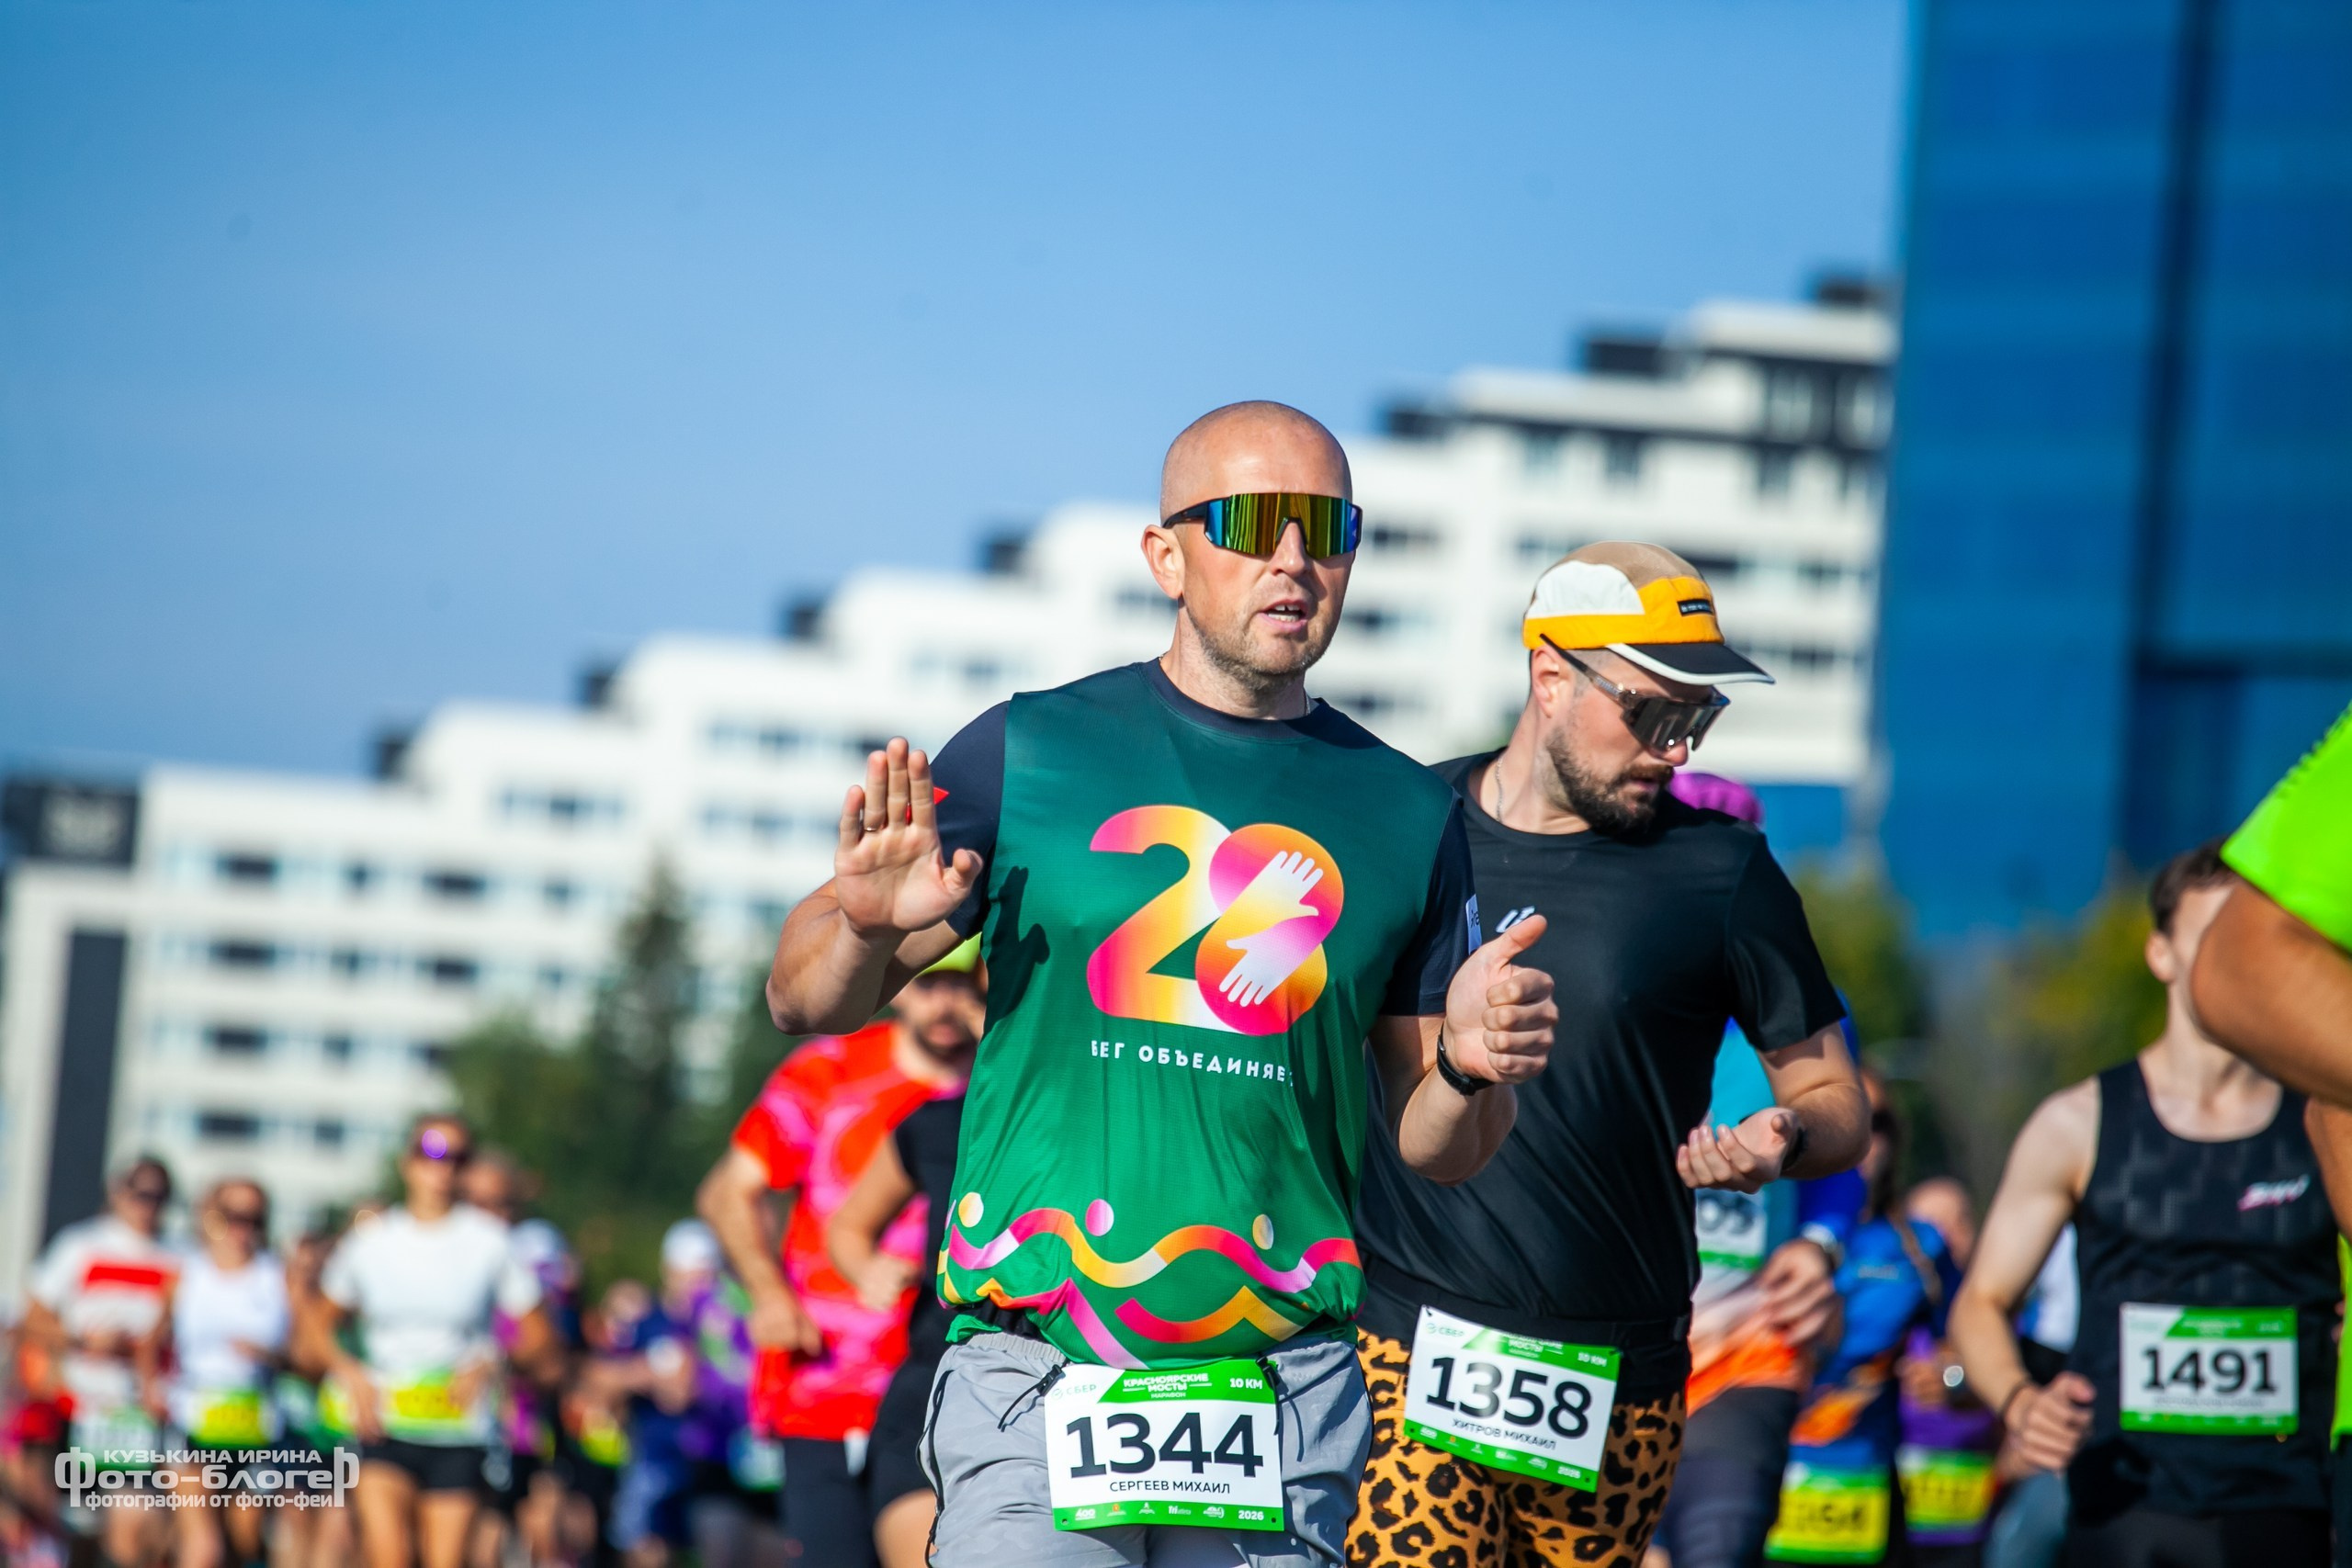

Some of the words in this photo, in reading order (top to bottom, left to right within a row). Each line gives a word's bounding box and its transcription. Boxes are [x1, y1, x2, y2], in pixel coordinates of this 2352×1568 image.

[1091, 1039, 1125, 1058] БЕГ
[1138, 1044, 1294, 1087] ОБЪЕДИНЯЕ
[2142, 1347, 2278, 1395] 1491
[1123, 1372, 1209, 1388] КРАСНОЯРСКИЕ
[1148, 1382, 1188, 1393] МОСТЫ
[1229, 1378, 1244, 1388] 10
[1066, 1383, 1097, 1395] СБЕР
[1426, 1357, 1592, 1439] 1358
[1452, 1418, 1501, 1438] ХИТРОВ
[1503, 1430, 1557, 1450] МИХАИЛ
[1066, 1412, 1264, 1479] 1344
[1109, 1479, 1170, 1493] СЕРГЕЕВ
[1172, 1481, 1231, 1495] МИХАИЛ
[1238, 1509, 1265, 1521] 2026
